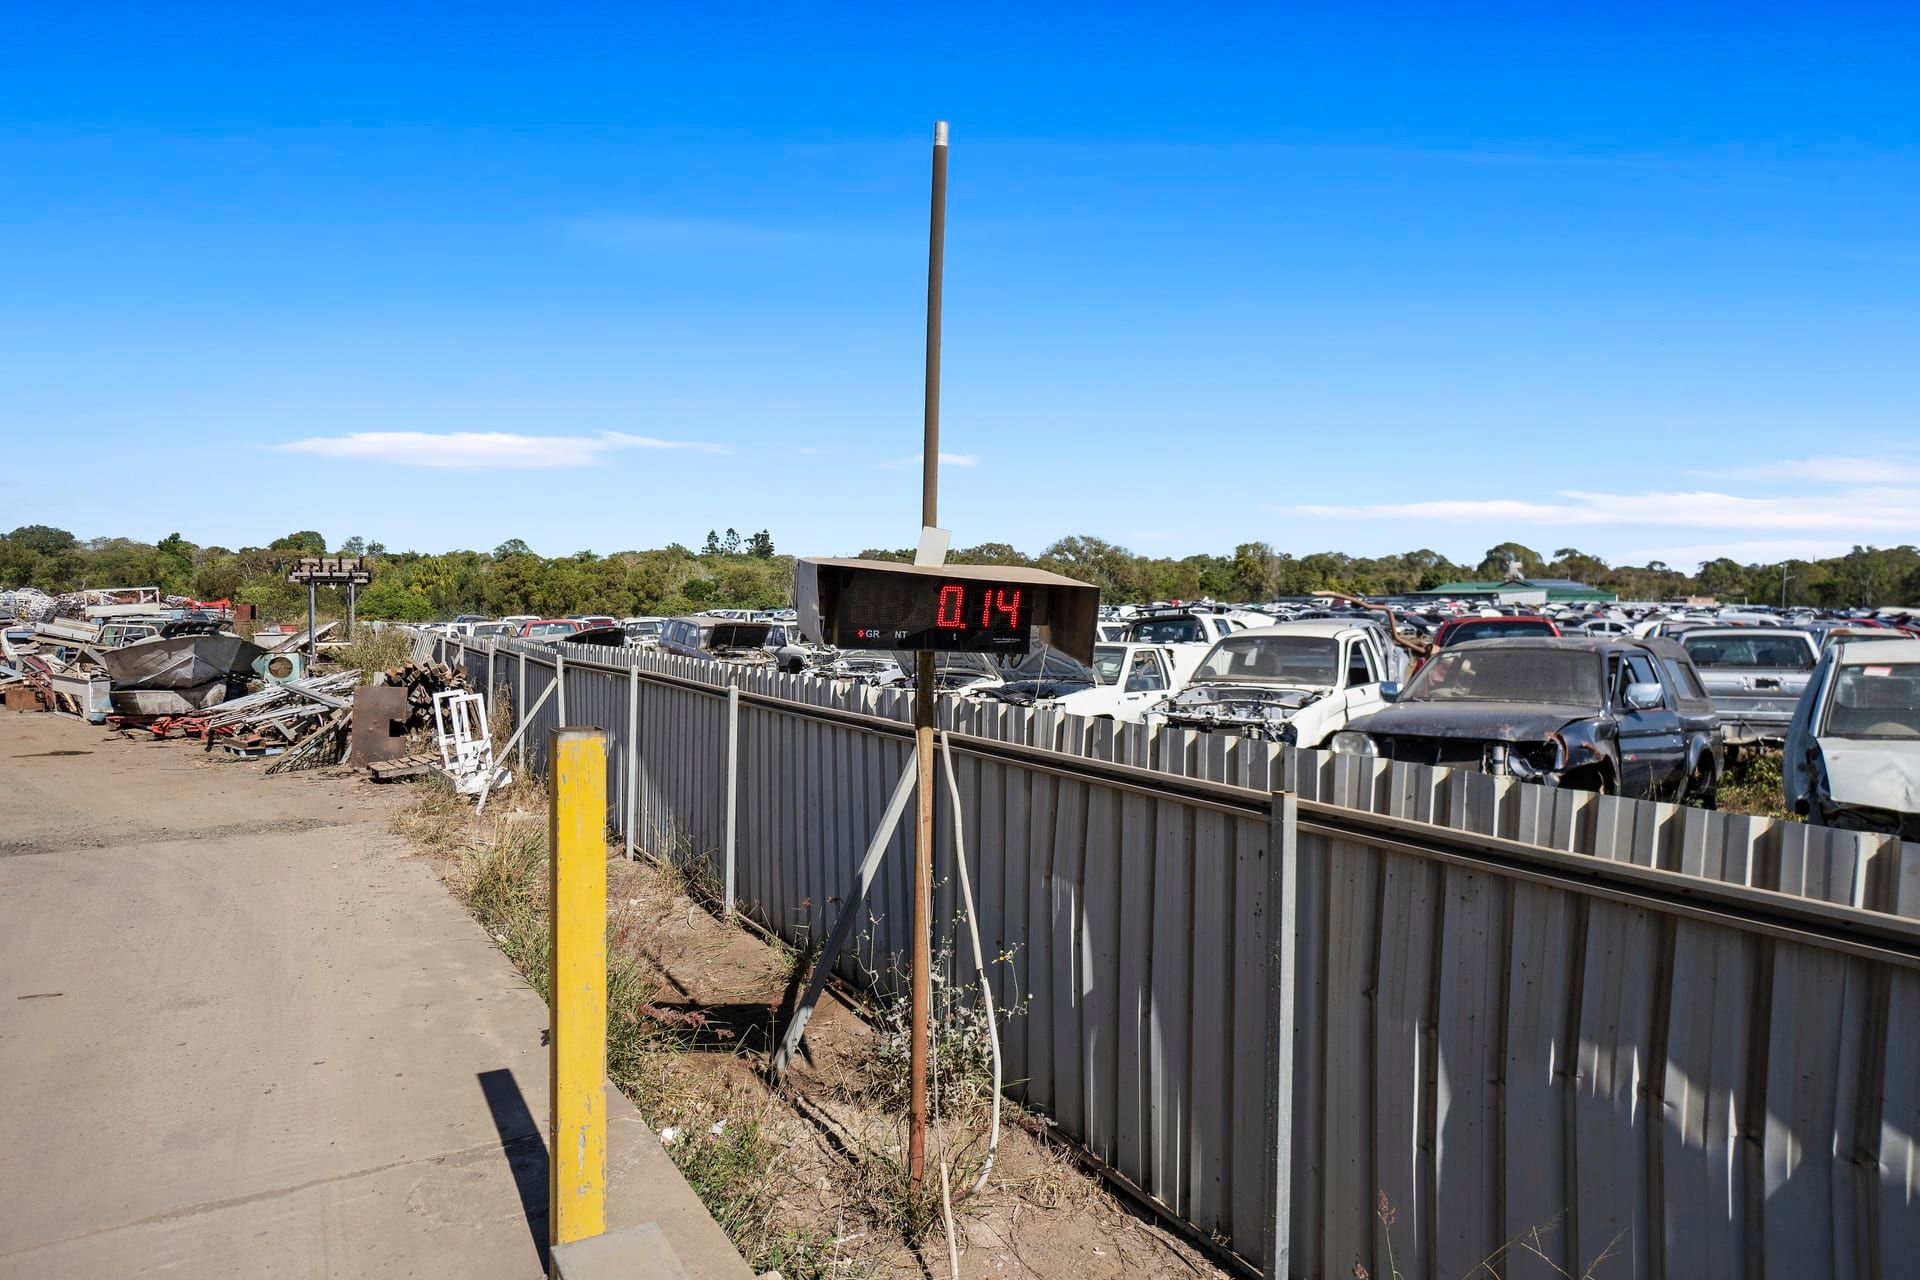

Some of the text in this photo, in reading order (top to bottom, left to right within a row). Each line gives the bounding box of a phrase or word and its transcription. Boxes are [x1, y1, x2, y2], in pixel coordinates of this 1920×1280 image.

[937, 585, 1020, 629] 0.14
[865, 629, 908, 639] GR NT
